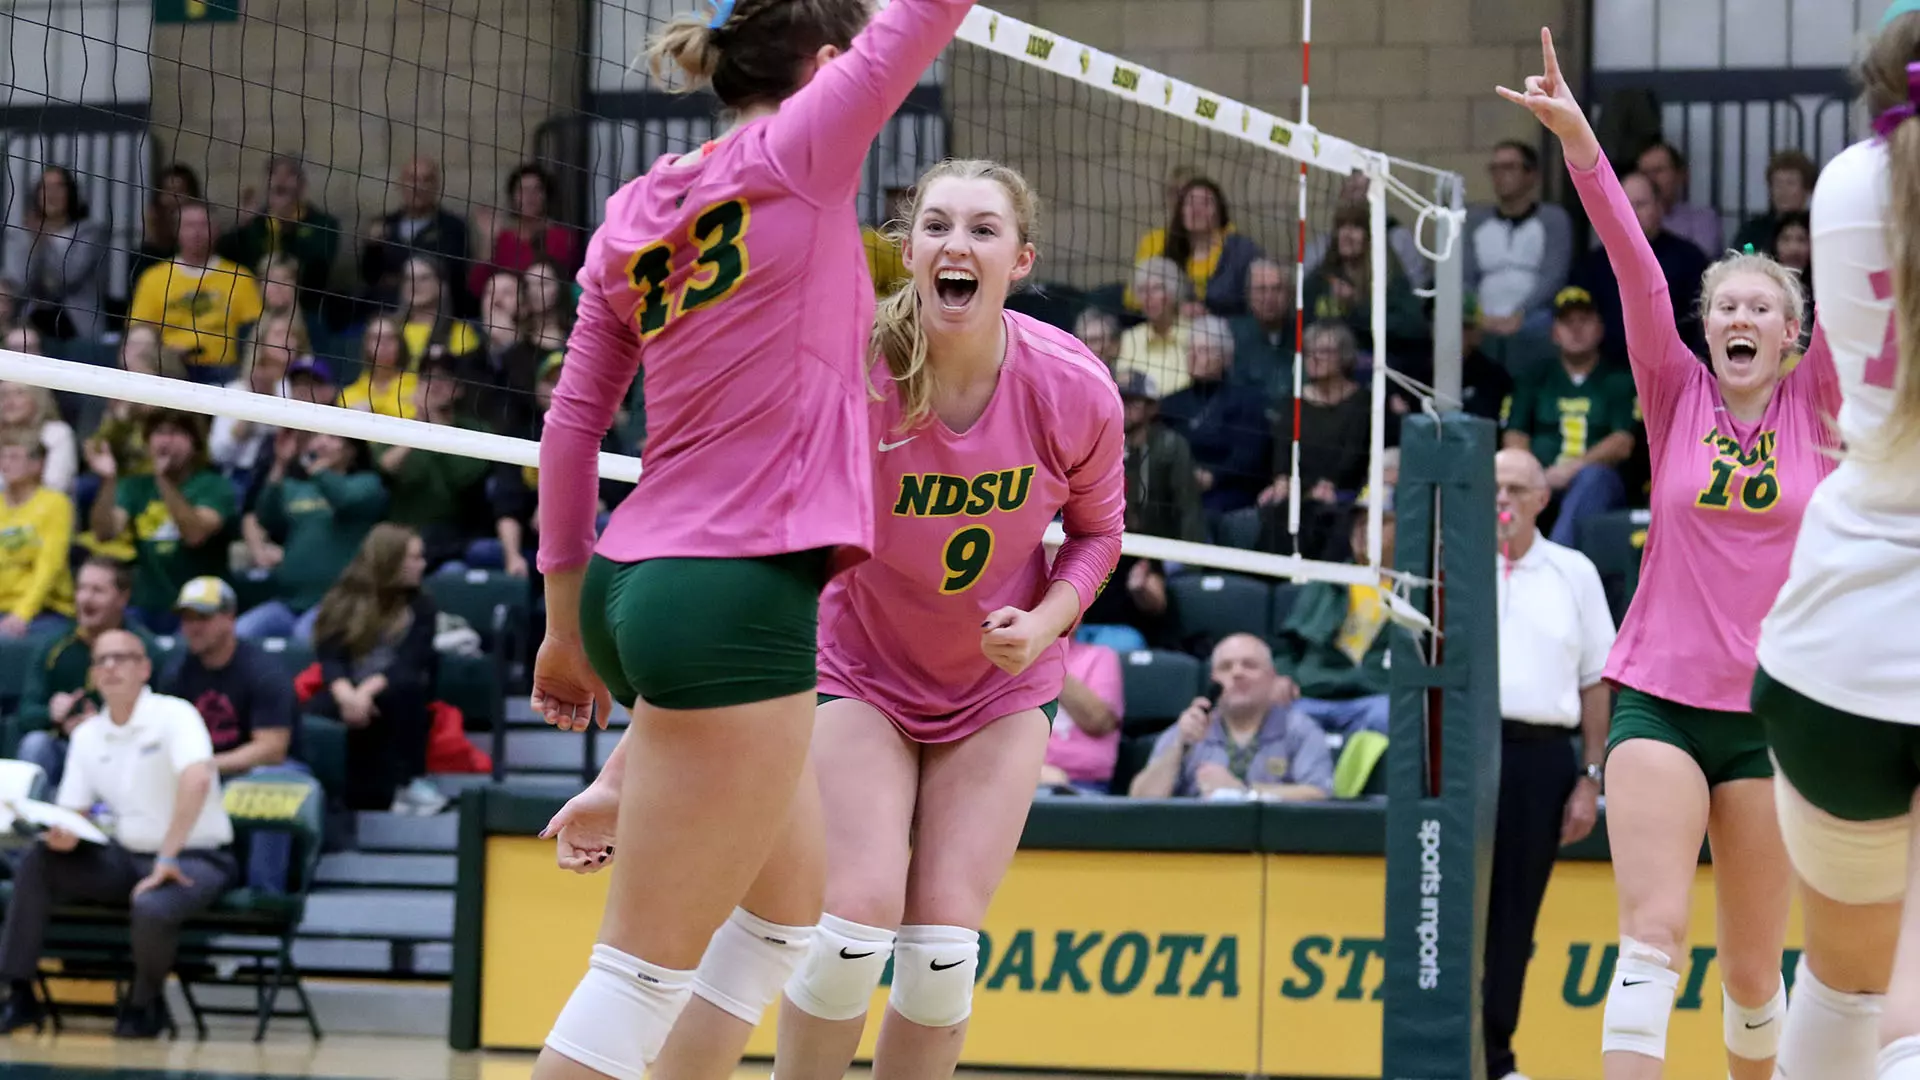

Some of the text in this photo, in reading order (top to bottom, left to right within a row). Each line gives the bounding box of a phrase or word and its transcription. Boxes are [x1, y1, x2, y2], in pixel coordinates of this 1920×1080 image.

[624, 197, 752, 343] 13
[892, 464, 1037, 517] NDSU
[1695, 456, 1781, 513] 16
[938, 523, 995, 596] 9
[1415, 819, 1442, 990] sports imports
[1281, 936, 1386, 1001] ST
